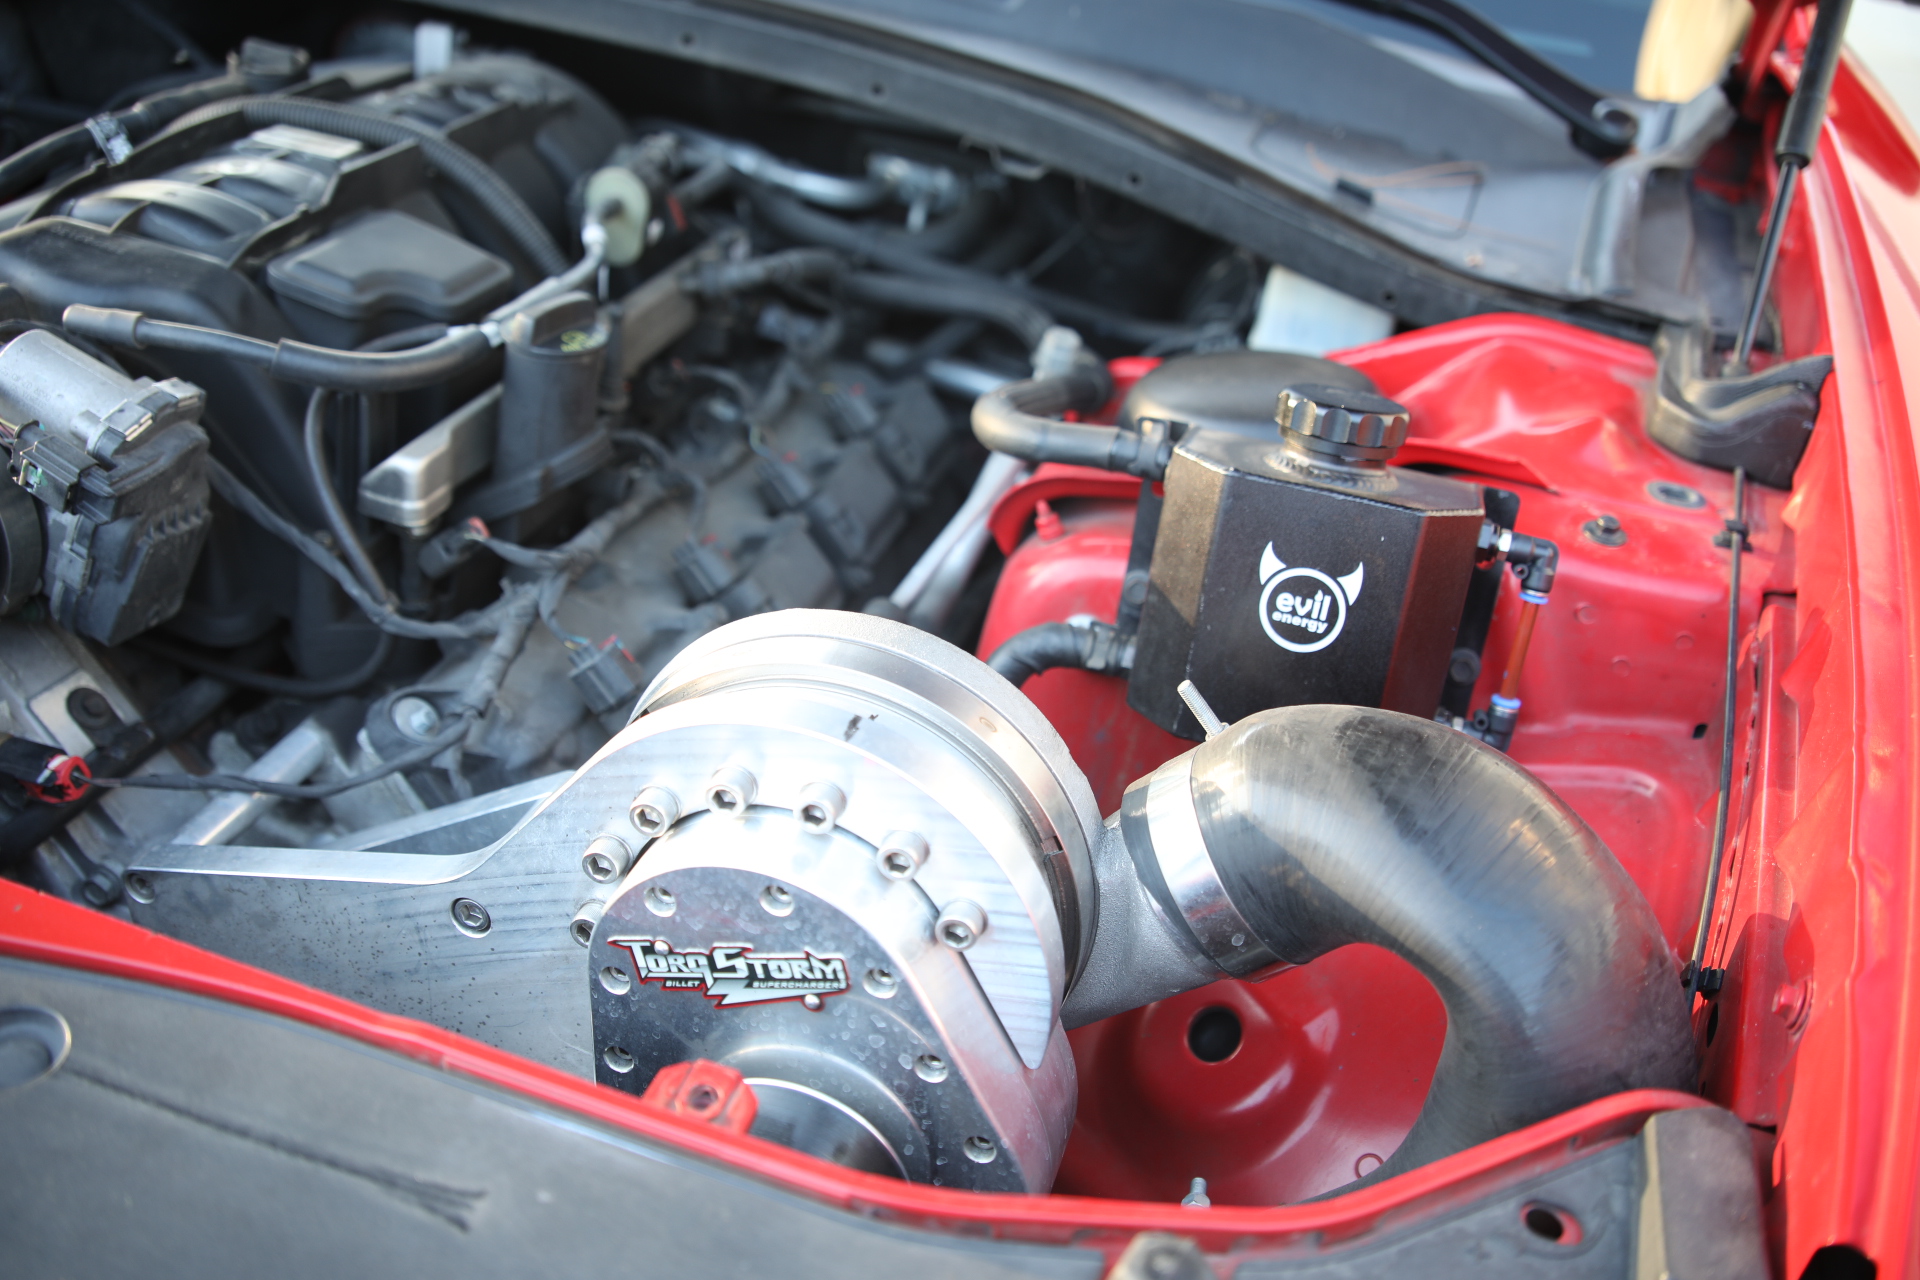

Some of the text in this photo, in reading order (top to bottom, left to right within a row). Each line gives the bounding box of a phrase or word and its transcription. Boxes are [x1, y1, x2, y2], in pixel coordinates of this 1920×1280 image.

[1275, 589, 1331, 621] evil
[1271, 611, 1328, 634] energy
[665, 979, 700, 988] BILLET
